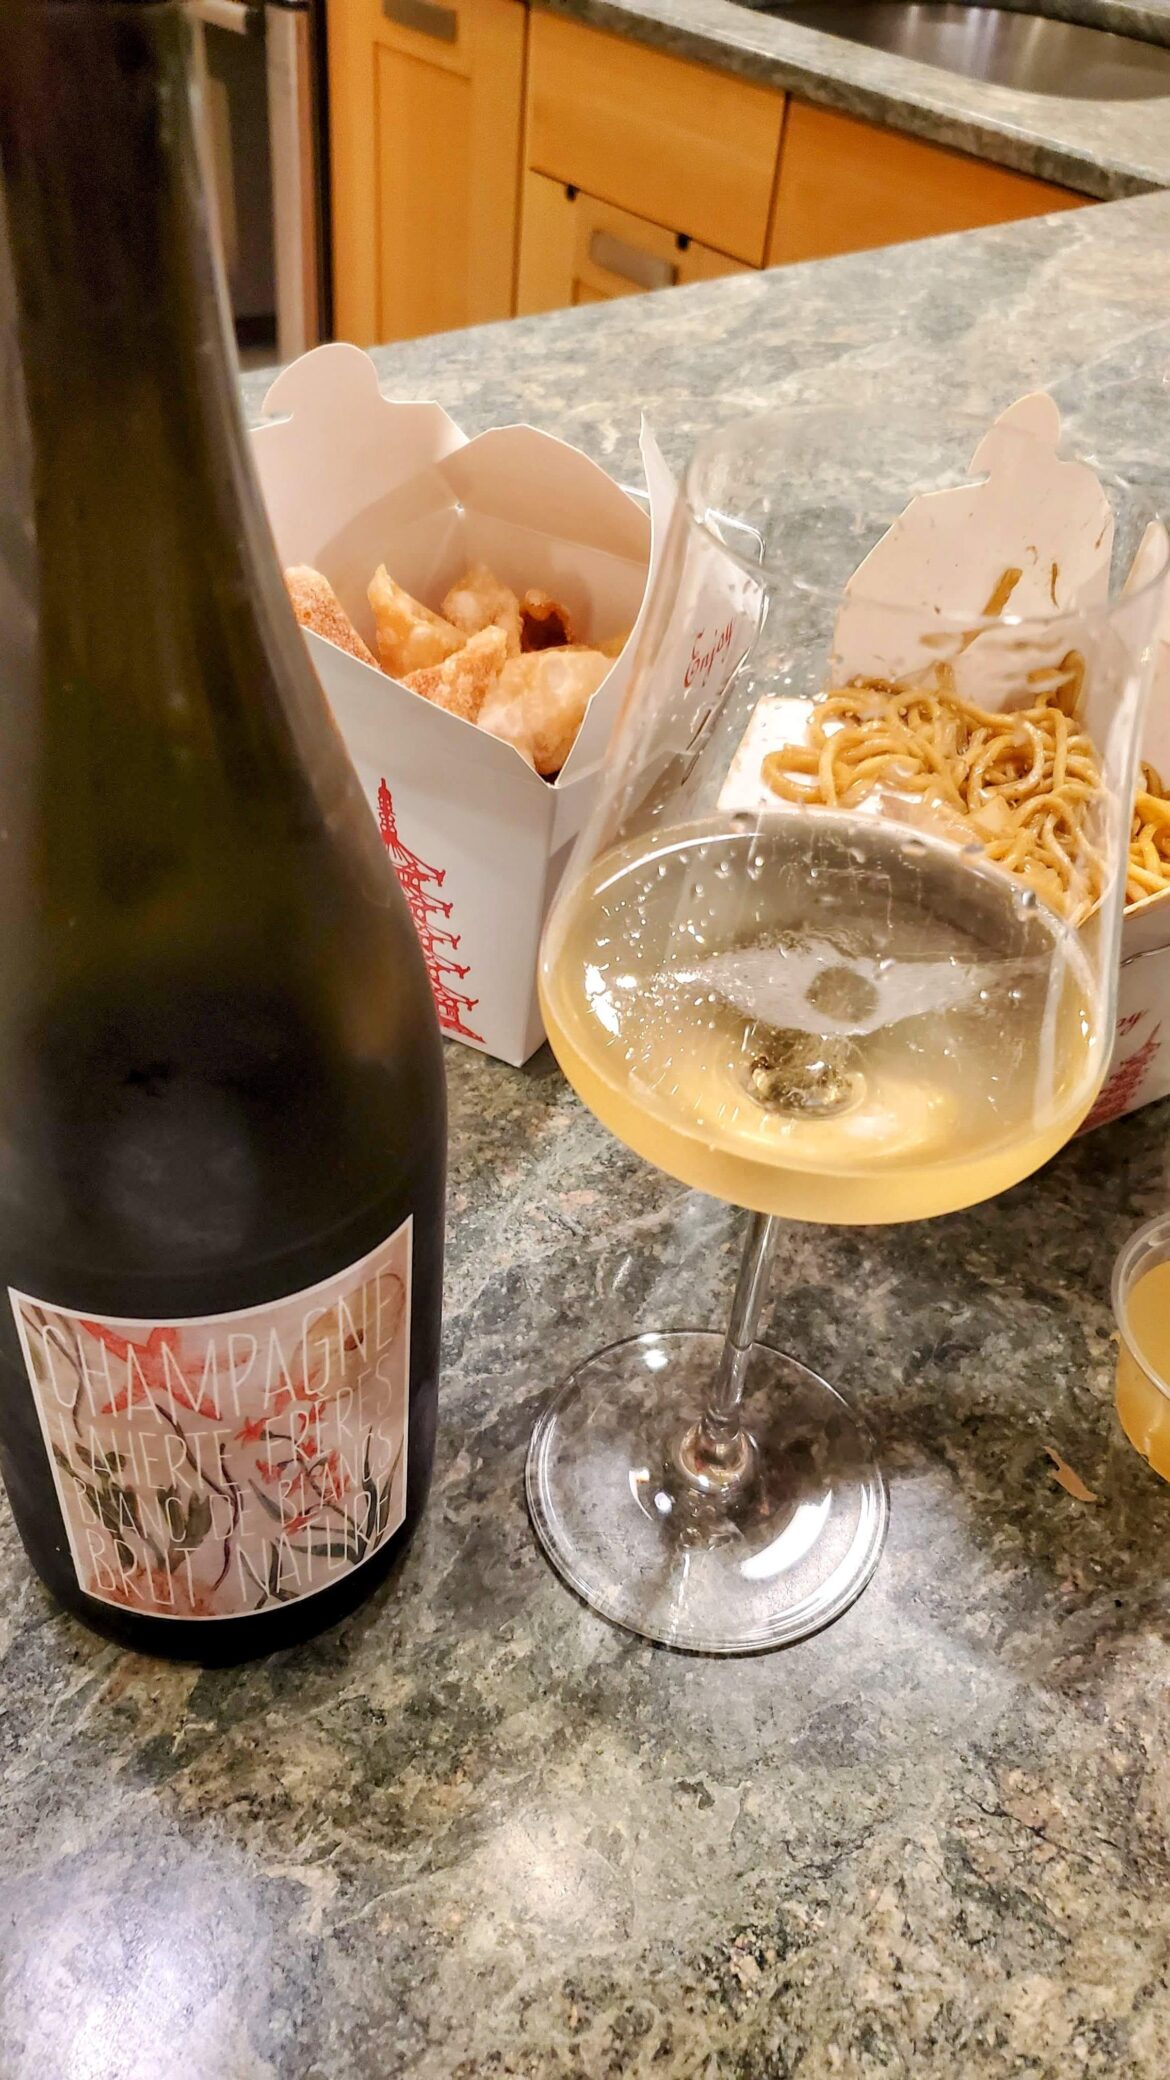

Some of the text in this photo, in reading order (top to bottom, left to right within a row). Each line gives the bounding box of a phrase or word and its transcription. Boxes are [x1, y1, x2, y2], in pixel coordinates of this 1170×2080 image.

[683, 617, 735, 688] Enjoy
[41, 1260, 393, 1424] CHAMPAGNE
[58, 1412, 240, 1490] LAHERTE
[72, 1417, 392, 1543] BLANC DE BLANCS
[86, 1467, 390, 1608] BRUT NATURE
